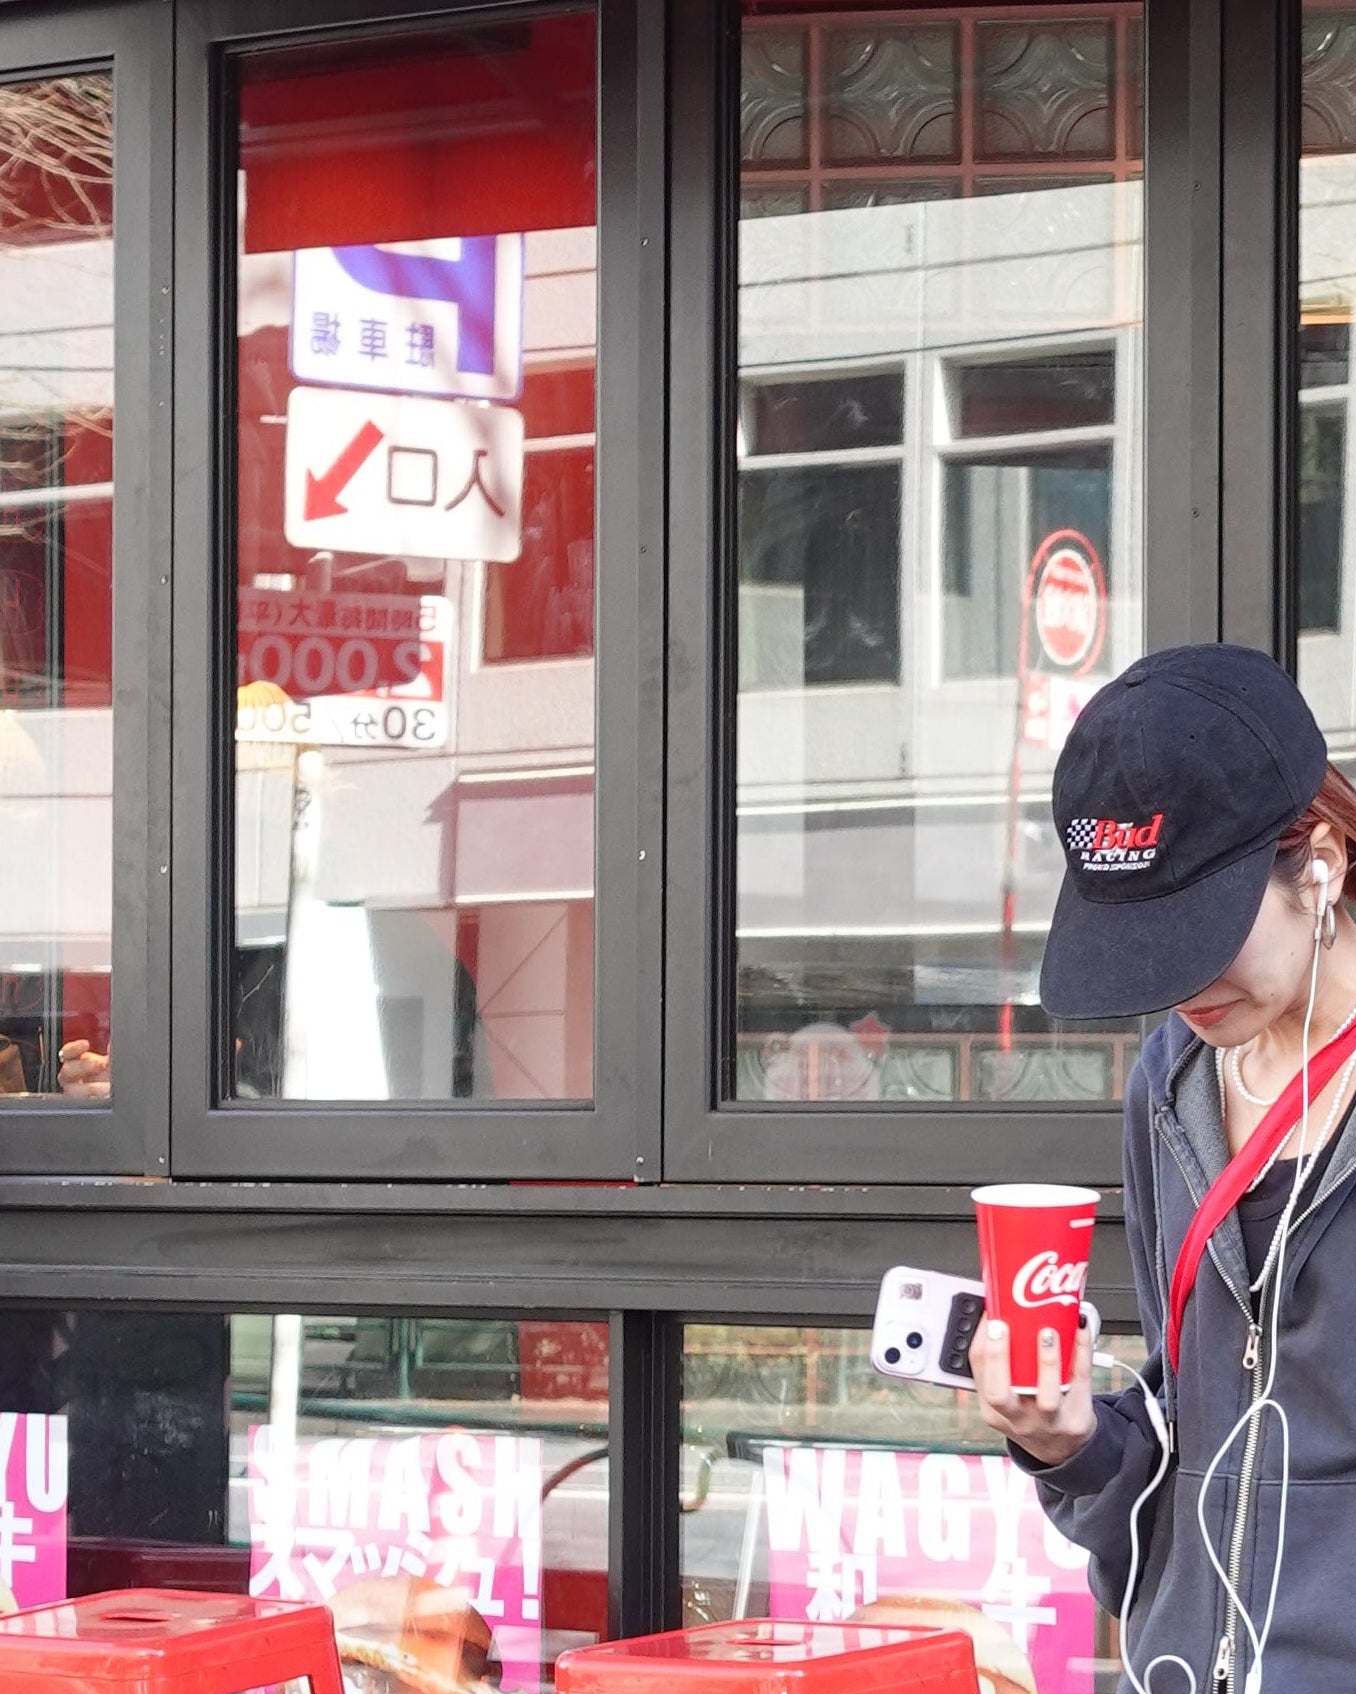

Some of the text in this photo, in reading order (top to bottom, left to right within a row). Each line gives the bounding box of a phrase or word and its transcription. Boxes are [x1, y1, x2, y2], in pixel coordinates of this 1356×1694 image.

[1091, 811, 1164, 850] Bud
[1080, 847, 1157, 862] RACING
[250, 1424, 542, 1539] SMASH
